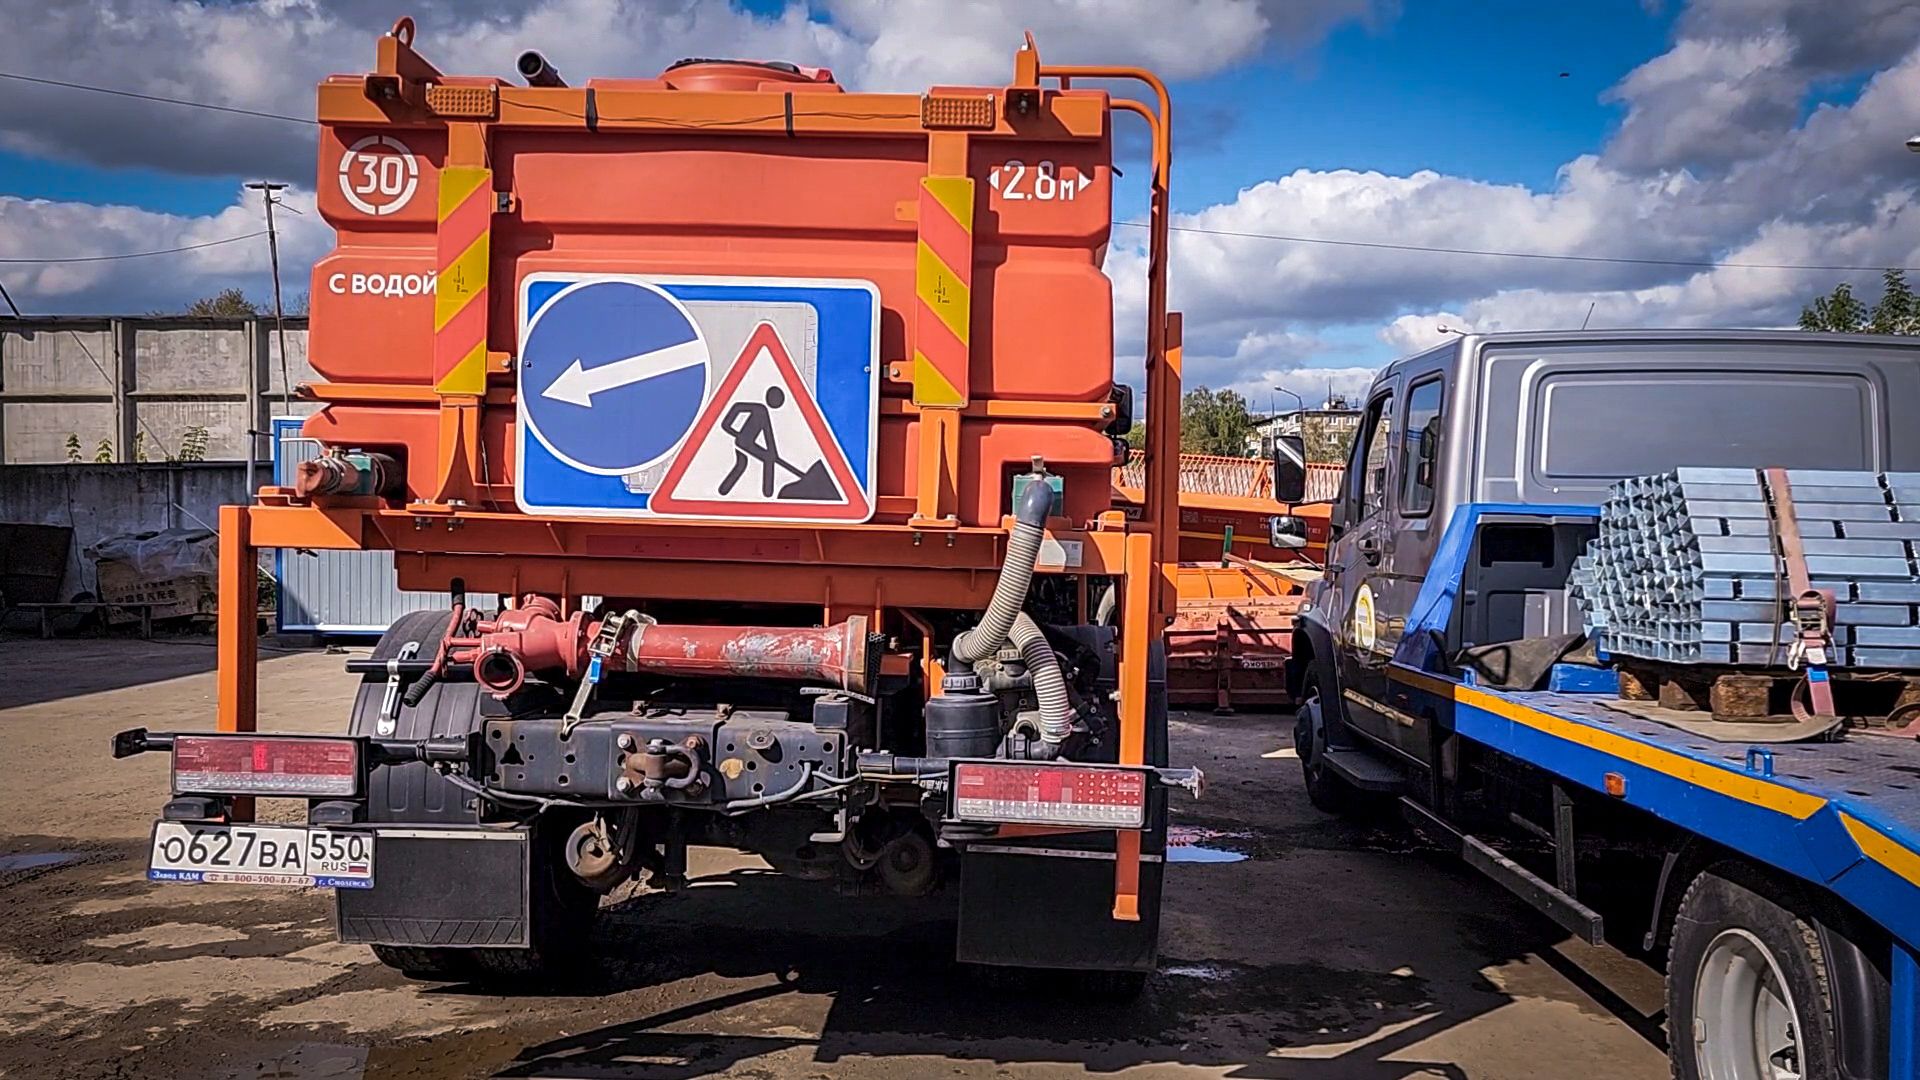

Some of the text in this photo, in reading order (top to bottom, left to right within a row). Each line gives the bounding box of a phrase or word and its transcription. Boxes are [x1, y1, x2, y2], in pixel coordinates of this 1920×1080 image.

[356, 155, 403, 195] 30
[329, 273, 346, 293] С
[351, 270, 437, 298] ВОДОЙ
[310, 833, 364, 861] 550
[321, 862, 347, 871] RUS
